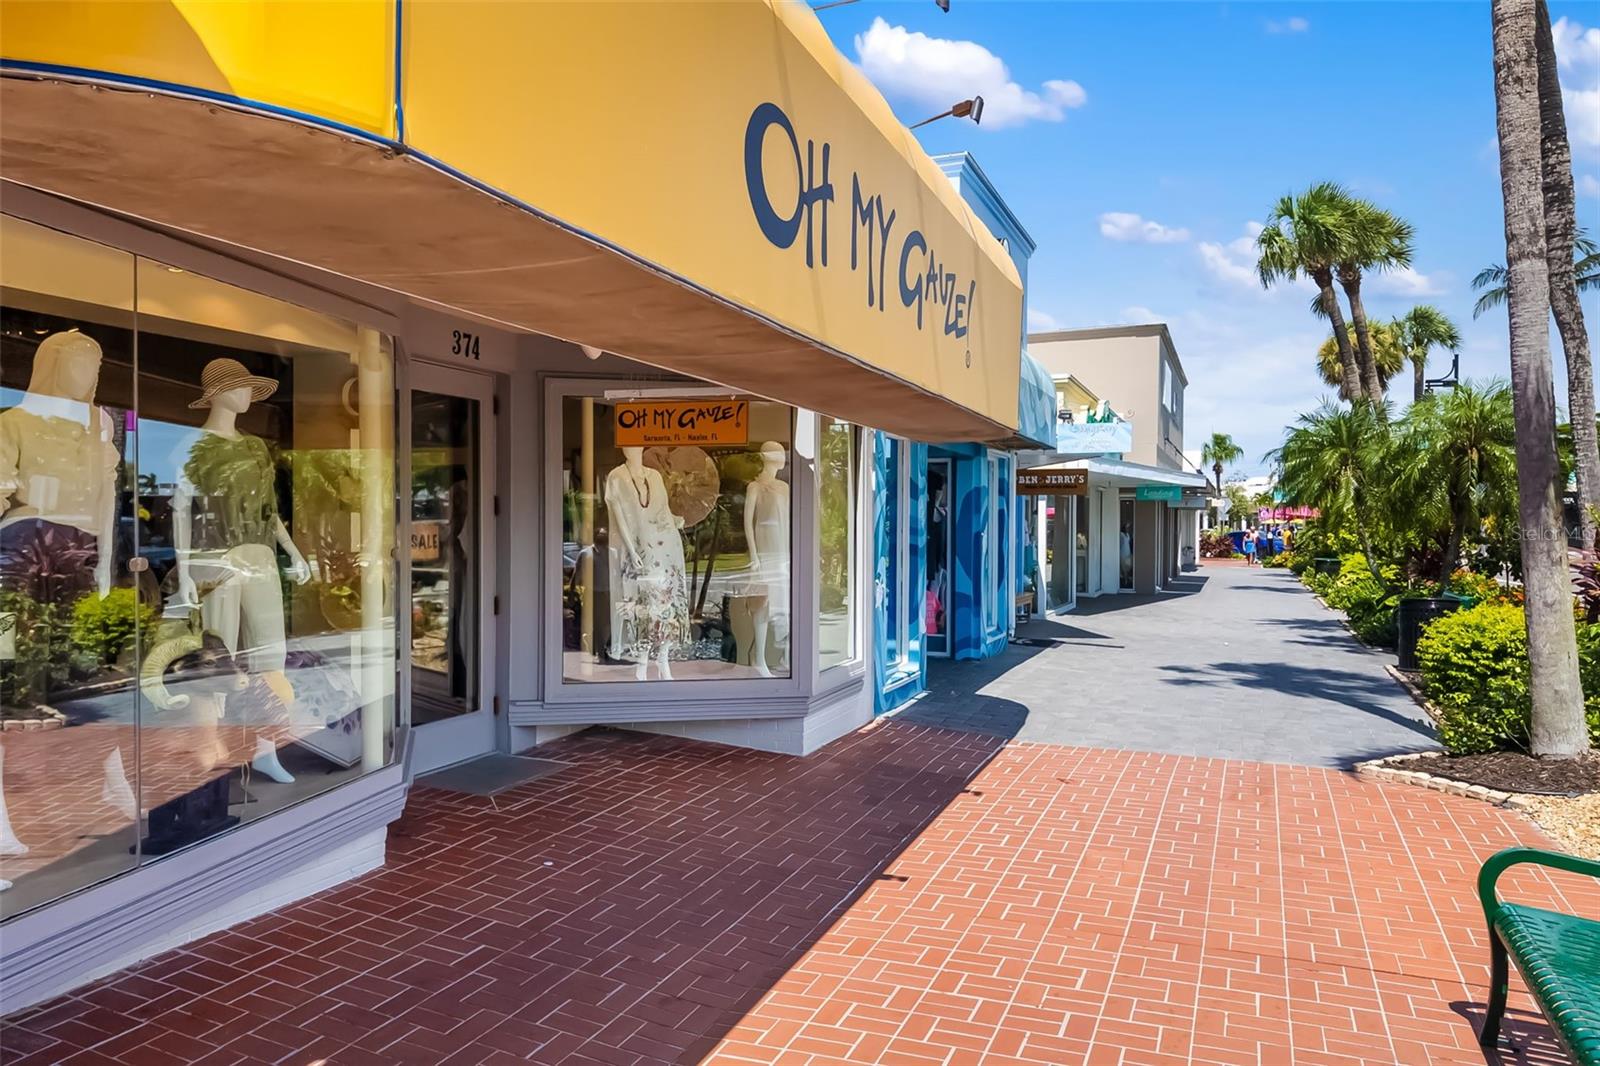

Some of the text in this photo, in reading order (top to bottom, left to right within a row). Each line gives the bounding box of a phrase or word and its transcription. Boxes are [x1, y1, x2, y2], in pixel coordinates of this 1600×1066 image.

[744, 102, 834, 269] OH
[851, 172, 896, 312] MY
[452, 330, 481, 361] 374
[618, 408, 648, 429] OH
[653, 407, 677, 430] MY
[1018, 475, 1038, 484] BEN
[1045, 474, 1085, 484] JERRY'S
[410, 533, 438, 550] SALE
